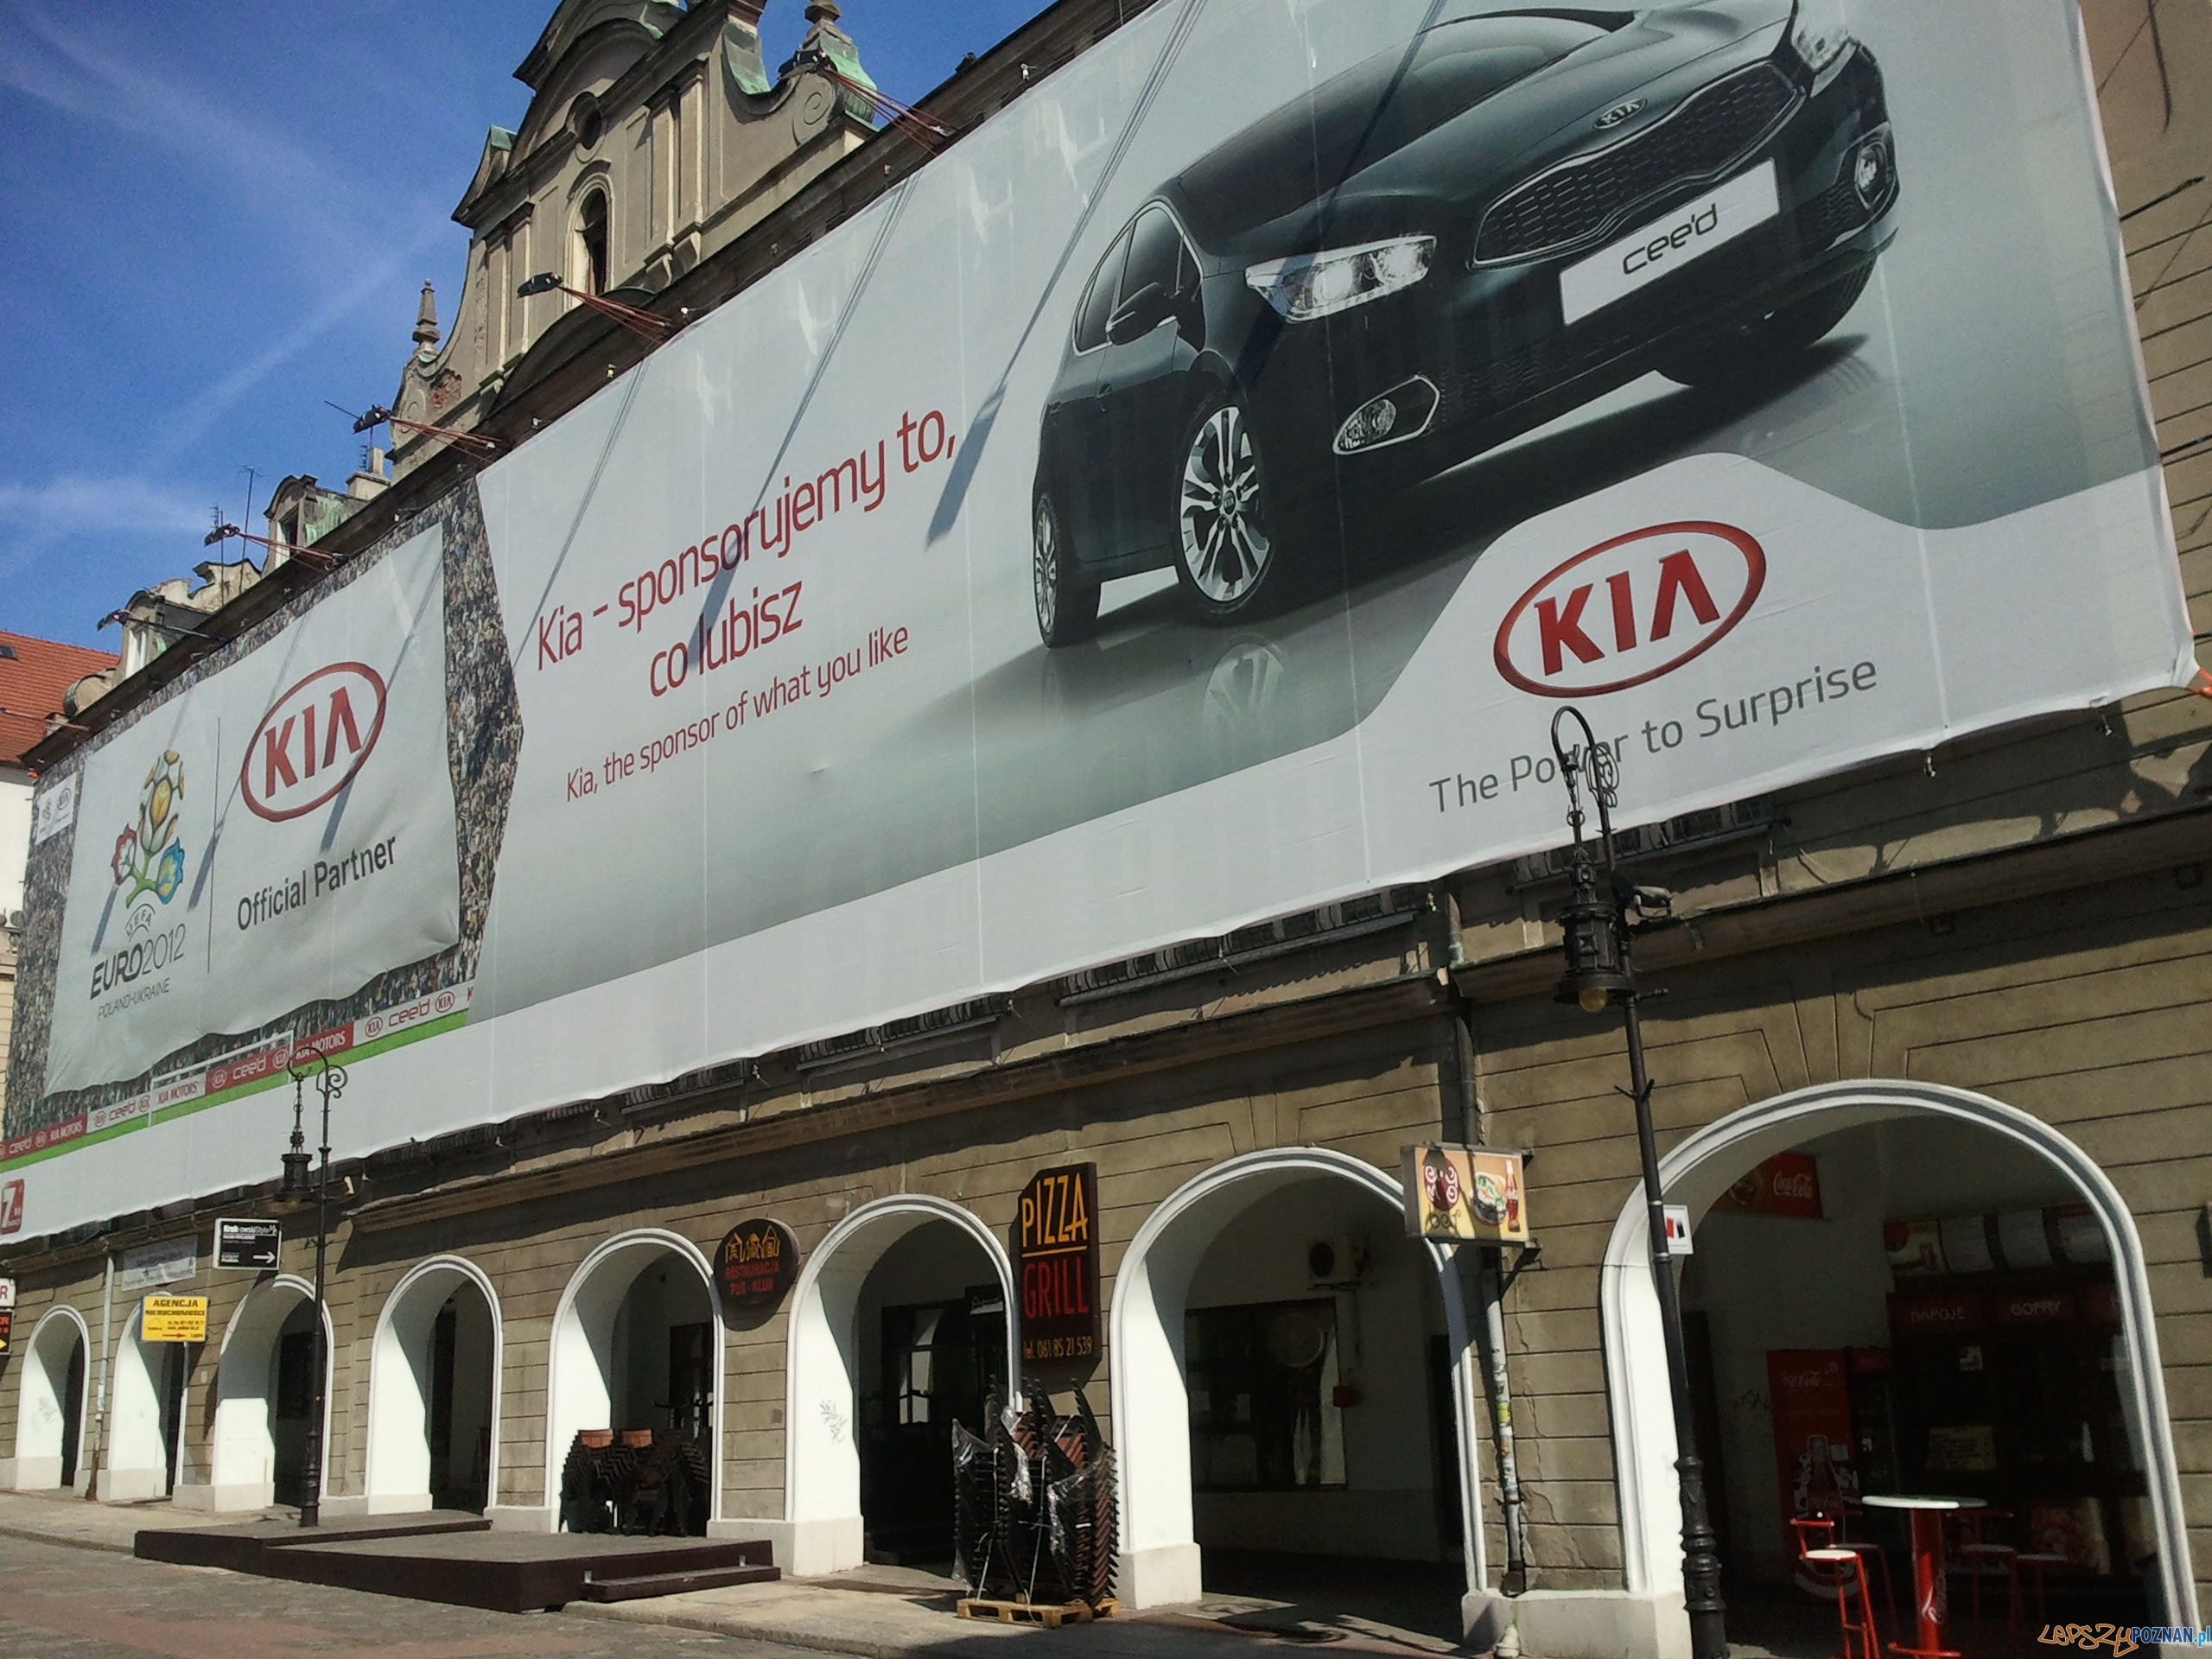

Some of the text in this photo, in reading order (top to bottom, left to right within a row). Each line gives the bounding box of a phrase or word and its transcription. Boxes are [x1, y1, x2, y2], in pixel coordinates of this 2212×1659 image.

[1601, 101, 1640, 124] KIA
[1623, 202, 1719, 275] cee'd
[537, 605, 583, 671] Kia
[618, 439, 886, 634] sponsorujemy
[896, 410, 957, 474] to,
[650, 580, 804, 697] co lubisz
[1533, 549, 1720, 677] KIA
[264, 685, 362, 799] KIA
[567, 626, 909, 803] Kia, the sponsor of what you like
[1428, 772, 1499, 813] The
[1642, 719, 1683, 754] to
[1696, 660, 1878, 738] Surprise
[238, 836, 397, 931] Official Partner
[1021, 1172, 1089, 1248] PIZZA
[153, 1299, 199, 1308] AGENCJA
[1023, 1257, 1090, 1319] GRILL
[1065, 1337, 1075, 1357] 21
